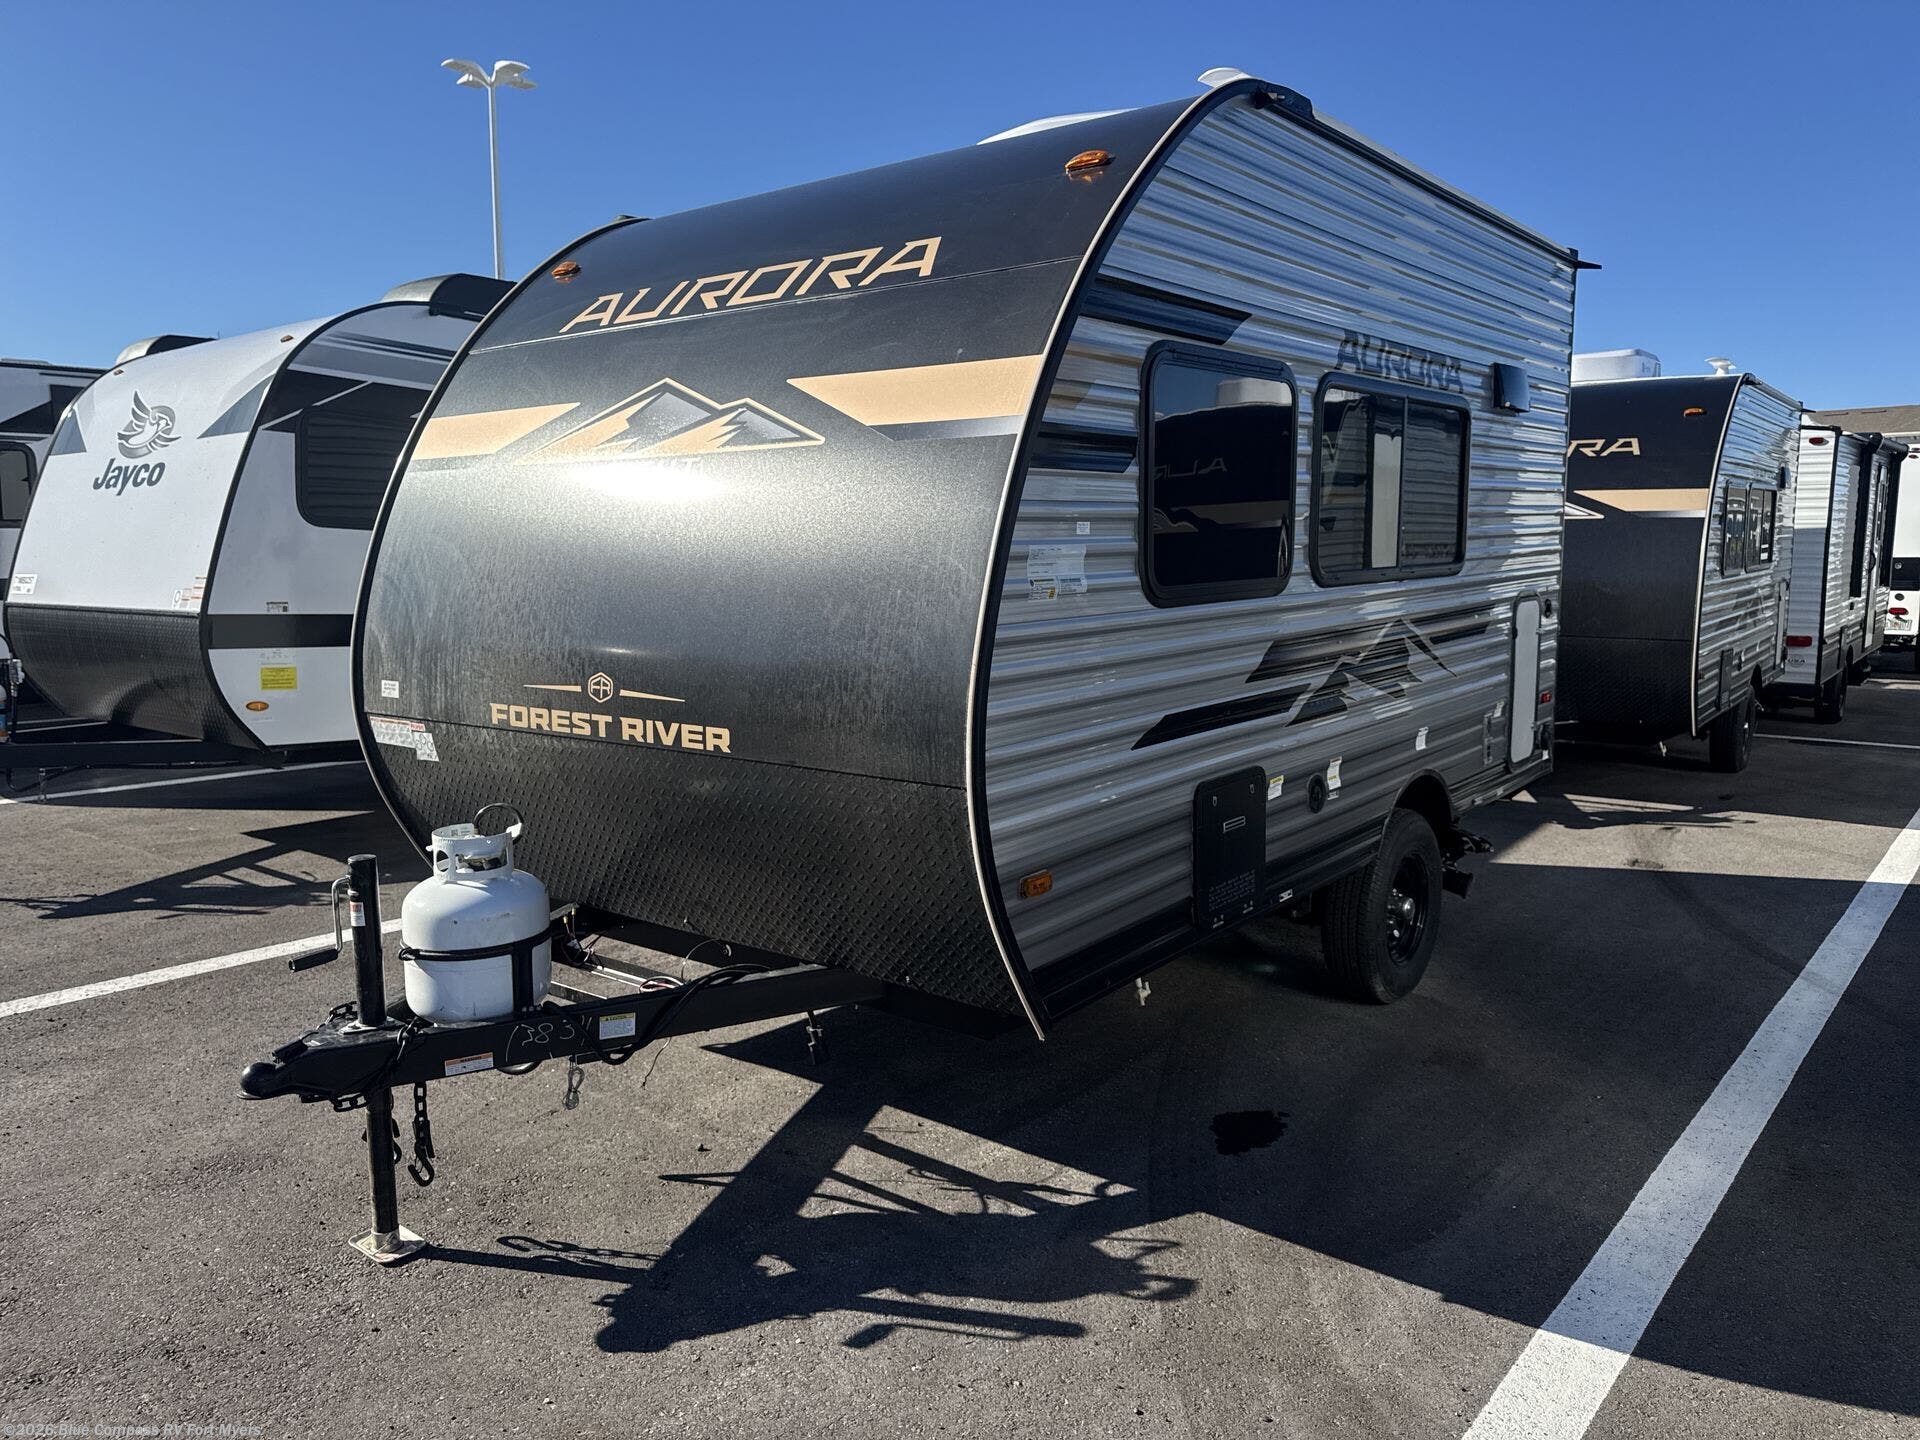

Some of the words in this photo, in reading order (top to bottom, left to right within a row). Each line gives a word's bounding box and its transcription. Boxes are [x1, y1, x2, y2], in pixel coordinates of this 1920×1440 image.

[558, 236, 942, 333] AURORA
[1334, 330, 1464, 394] AURORA
[92, 457, 166, 496] Jayco
[490, 702, 612, 738] FOREST
[619, 716, 732, 754] RIVER
